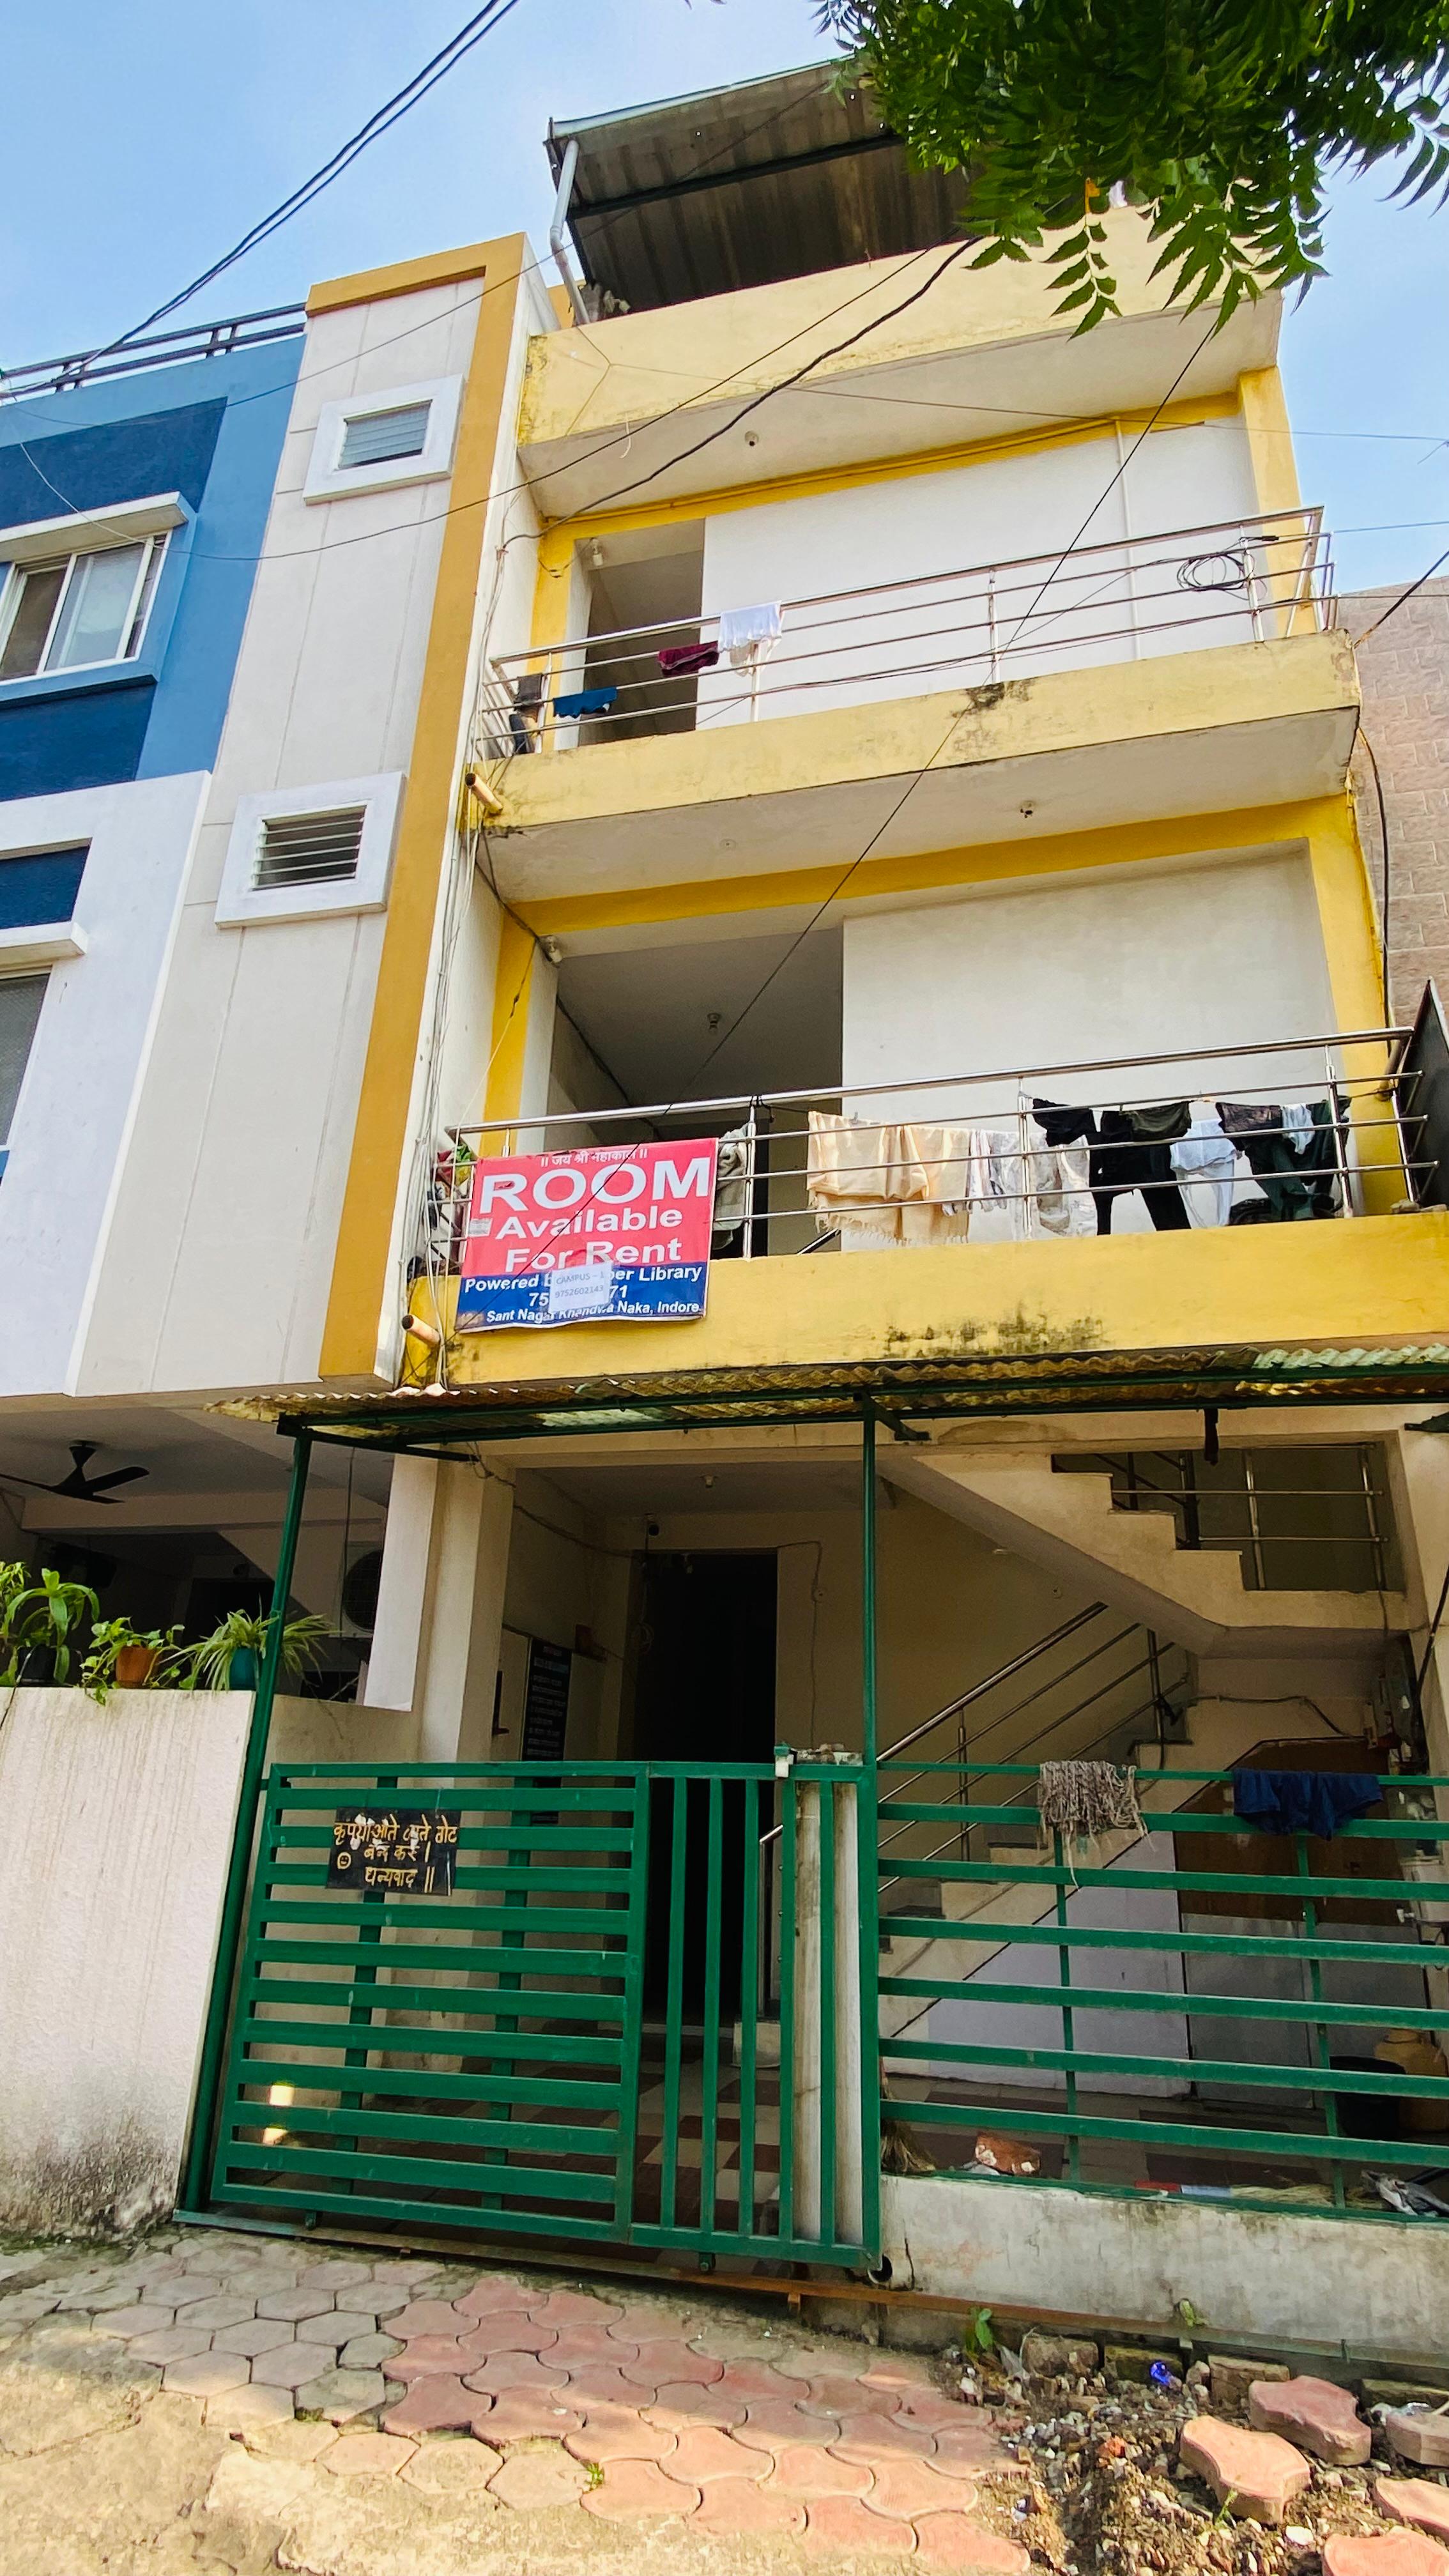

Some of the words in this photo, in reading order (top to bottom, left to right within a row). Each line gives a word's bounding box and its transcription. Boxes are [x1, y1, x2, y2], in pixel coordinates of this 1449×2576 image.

[552, 1154, 572, 1166] जय
[574, 1149, 589, 1164] श्री
[479, 1157, 710, 1214] ROOM
[495, 1205, 683, 1240] Available
[505, 1248, 574, 1273] For
[585, 1237, 682, 1266] Rent
[465, 1273, 540, 1293] Powered
[638, 1266, 702, 1282] Library
[486, 1307, 515, 1322] Sant
[364, 1866, 418, 1889] धन्यवाद
